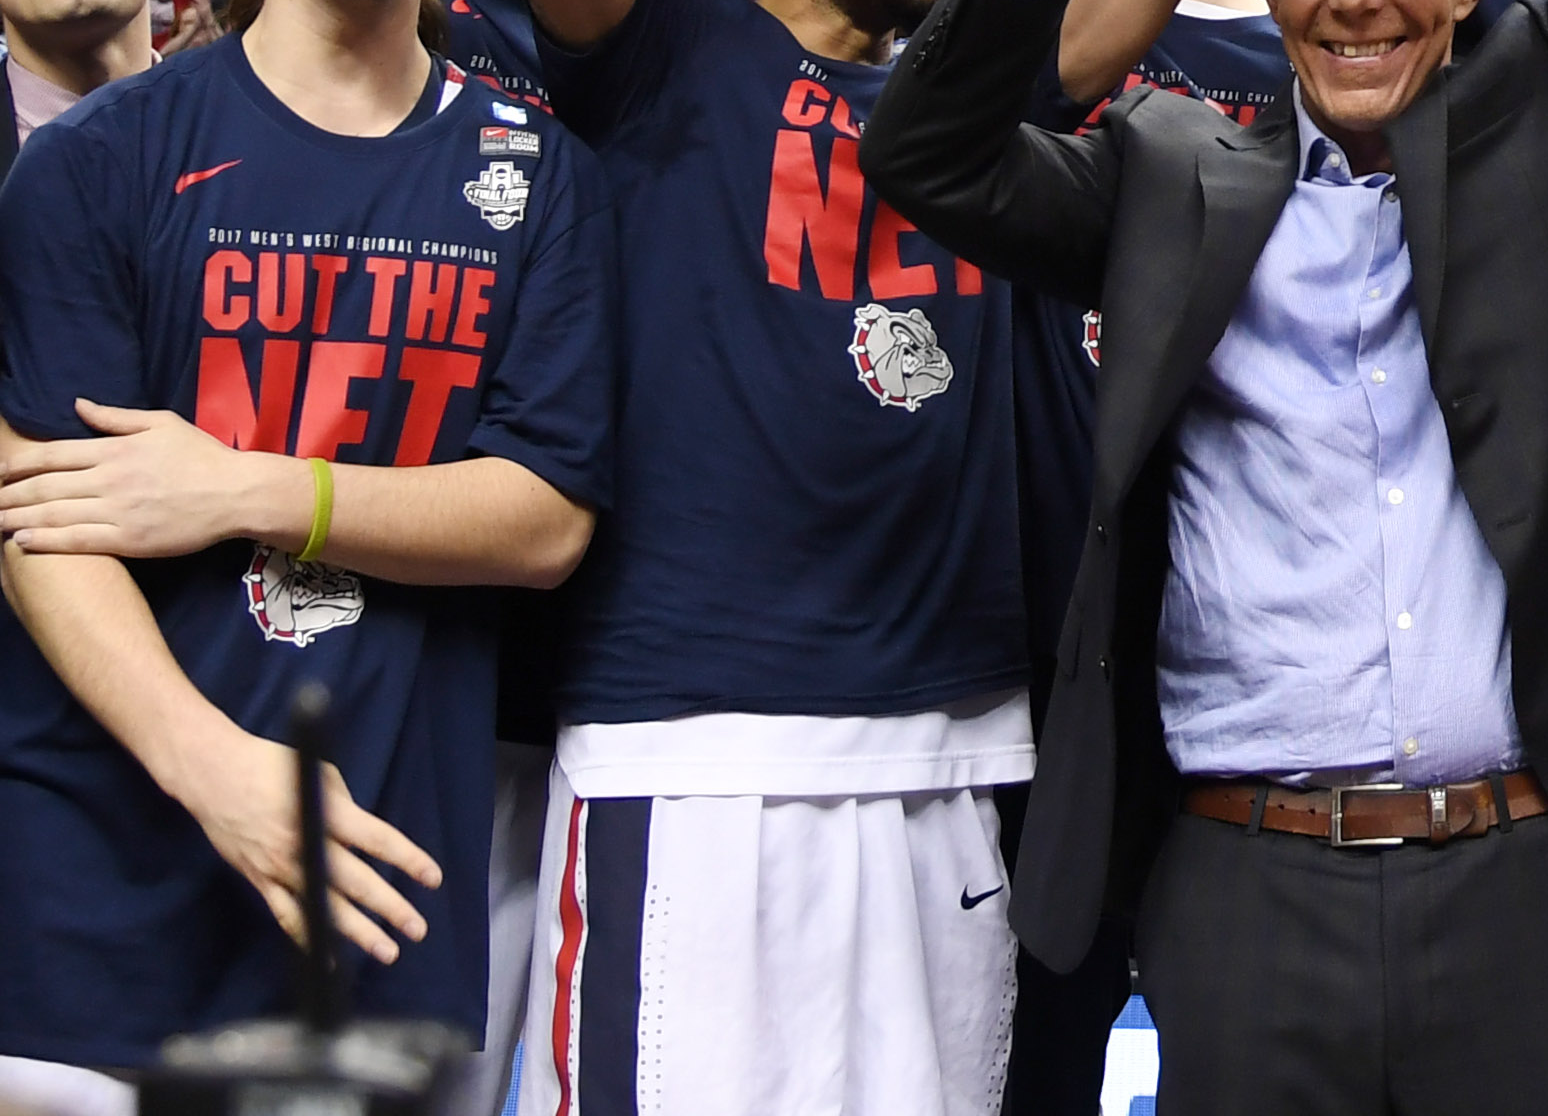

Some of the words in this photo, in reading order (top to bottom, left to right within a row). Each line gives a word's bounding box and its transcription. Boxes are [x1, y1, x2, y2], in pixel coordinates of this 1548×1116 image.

[473, 188, 501, 201] FINAL
[763, 129, 983, 301] NE
[208, 228, 242, 244] 2017
[250, 231, 294, 247] MEN'S
[303, 234, 340, 250] WEST
[347, 236, 413, 254] REGIONAL
[422, 241, 498, 265] CHAMPIONS
[202, 249, 349, 334] CUT
[365, 257, 497, 348] THE
[195, 337, 483, 467] NET
